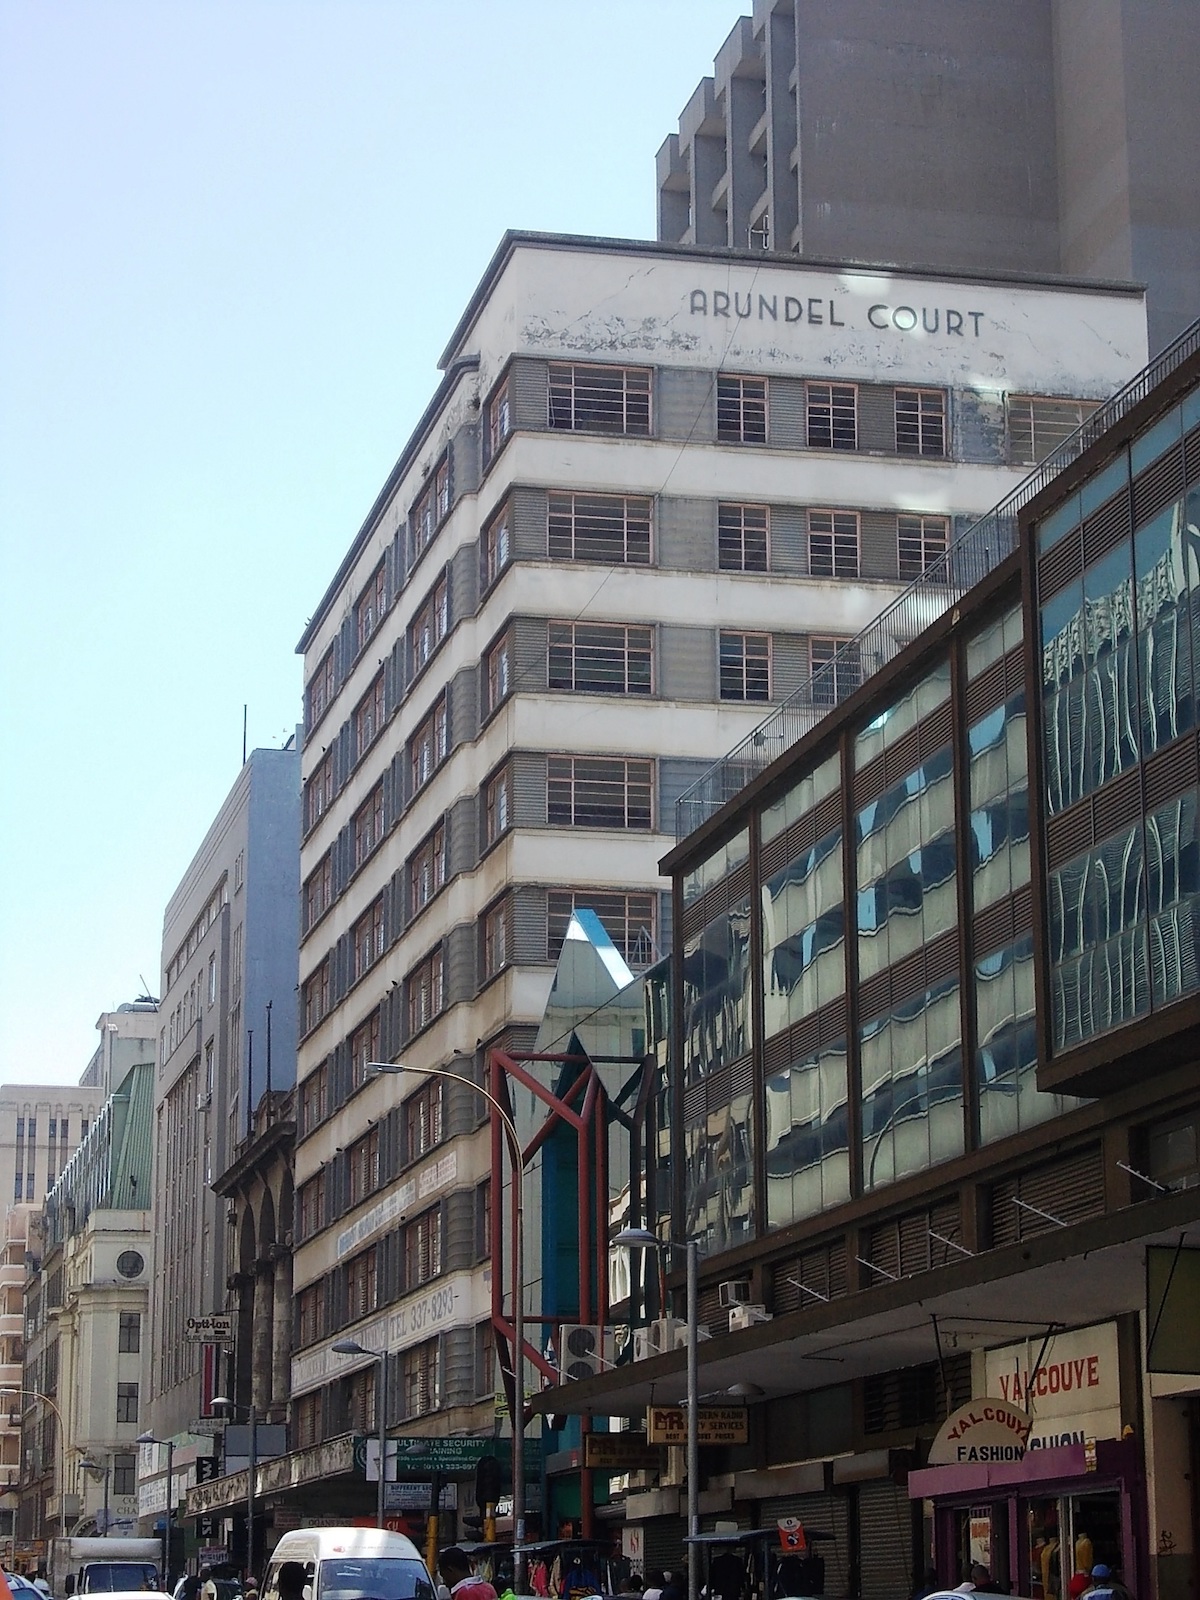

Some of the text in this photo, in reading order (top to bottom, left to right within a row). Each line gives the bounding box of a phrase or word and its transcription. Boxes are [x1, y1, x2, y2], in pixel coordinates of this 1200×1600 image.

[690, 289, 985, 337] ARUNDEL COURT
[390, 1285, 454, 1342] TEL 337-8293
[999, 1356, 1099, 1401] YALCOUYE
[710, 1422, 744, 1430] SERVICES
[443, 1439, 487, 1447] SECURITY
[957, 1446, 1024, 1461] FASHION
